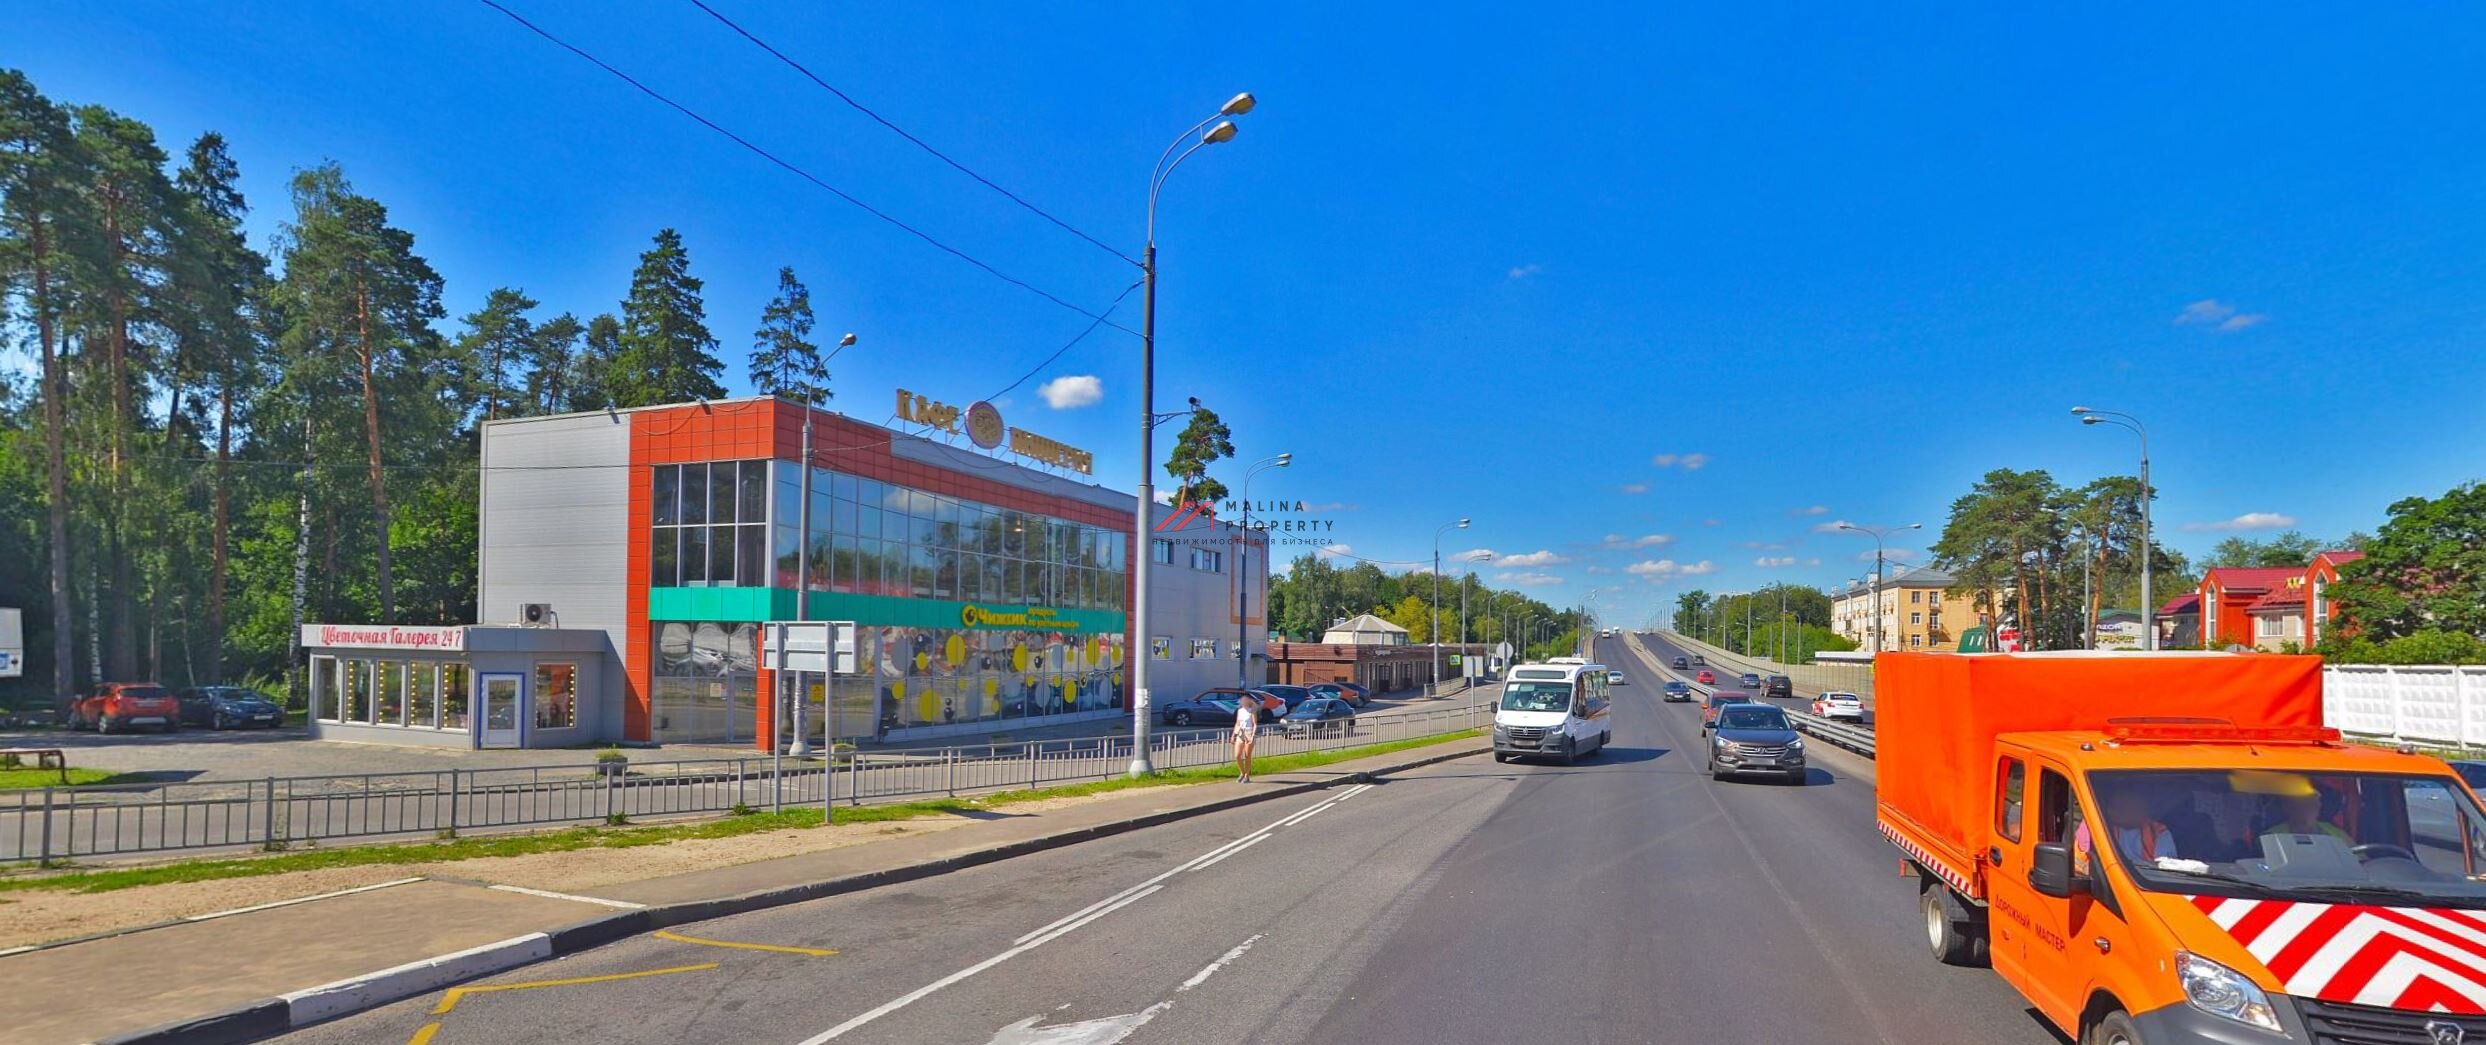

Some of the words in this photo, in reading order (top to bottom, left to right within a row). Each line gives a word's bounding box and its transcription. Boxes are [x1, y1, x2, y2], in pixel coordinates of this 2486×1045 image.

[896, 387, 960, 435] КАФЕ
[977, 607, 1027, 625] Чижик
[321, 626, 387, 646] Цветочная
[390, 627, 438, 647] Галерея
